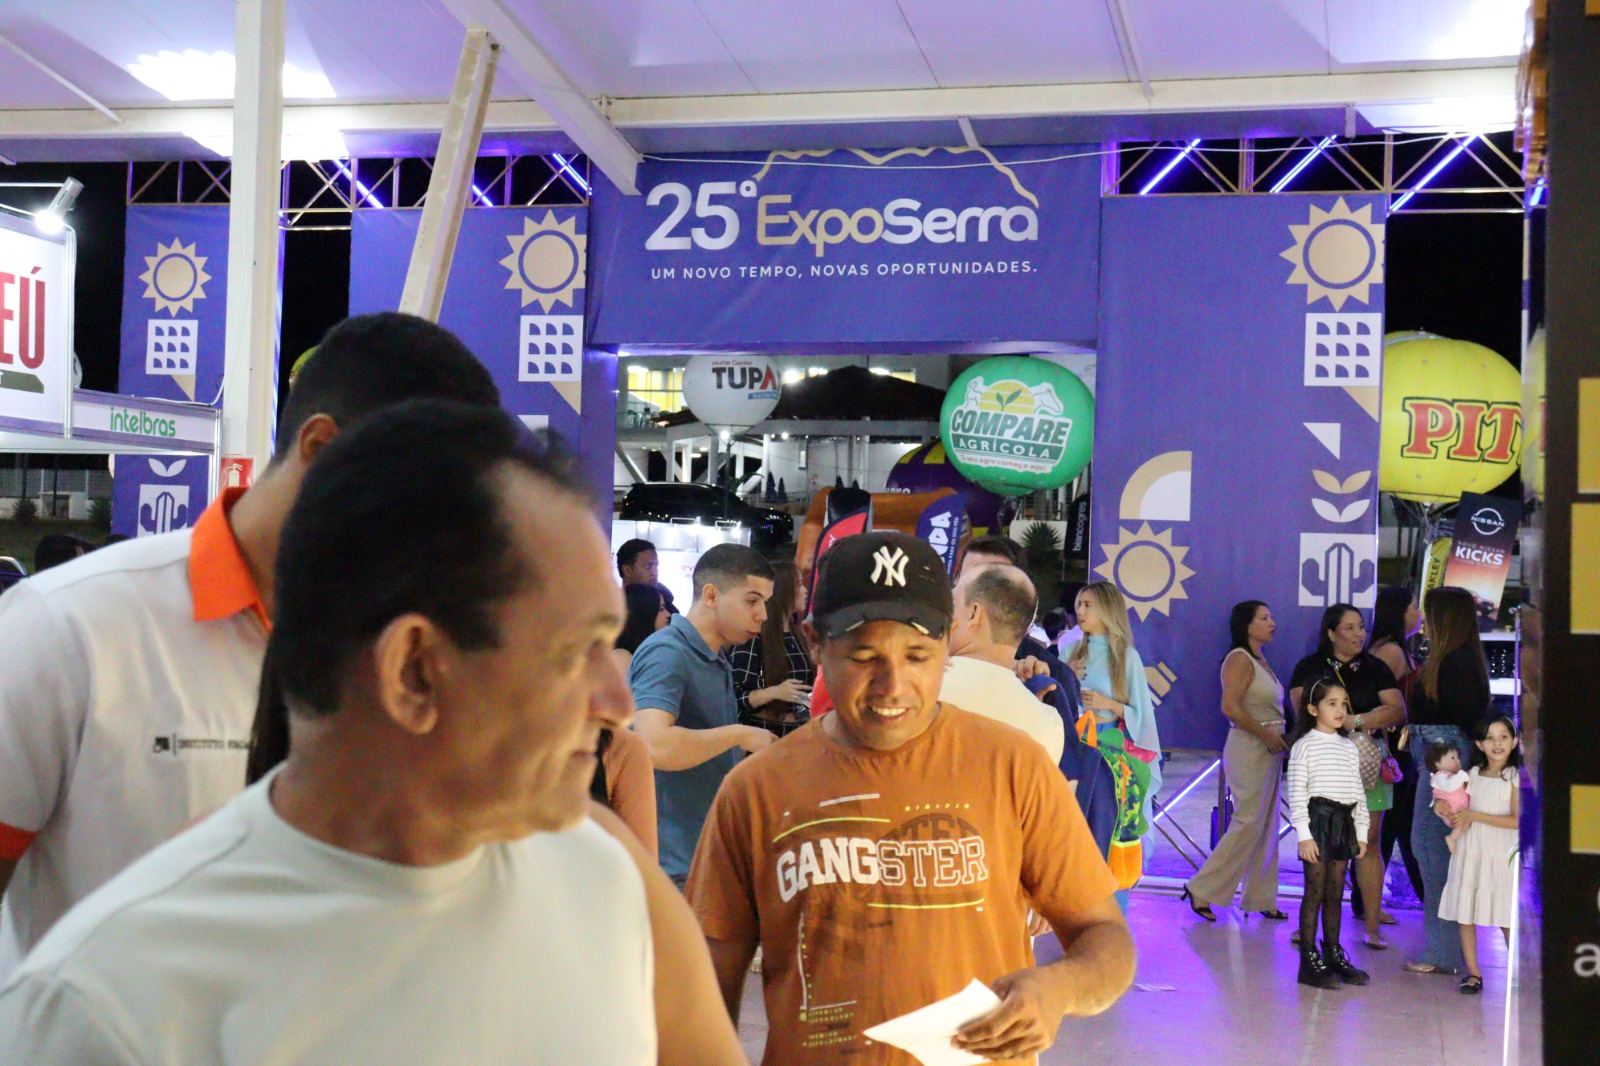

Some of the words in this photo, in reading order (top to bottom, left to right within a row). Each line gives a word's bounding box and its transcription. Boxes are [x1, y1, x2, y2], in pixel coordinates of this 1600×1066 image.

[756, 194, 1039, 258] ExpoSerra
[651, 267, 676, 280] UM
[683, 266, 731, 279] NOVO
[739, 265, 803, 279] TEMPO,
[810, 264, 869, 277] NOVAS
[877, 260, 1037, 276] OPORTUNIDADES.
[110, 406, 176, 438] intelbras
[951, 408, 1071, 446] COMPARE
[959, 437, 1051, 459] AGRÍCOLA
[1072, 501, 1087, 552] biancogres
[1471, 516, 1505, 528] NISSAN
[870, 545, 909, 587] NY
[1455, 546, 1504, 566] KICKS
[776, 835, 989, 903] GANGSTER
